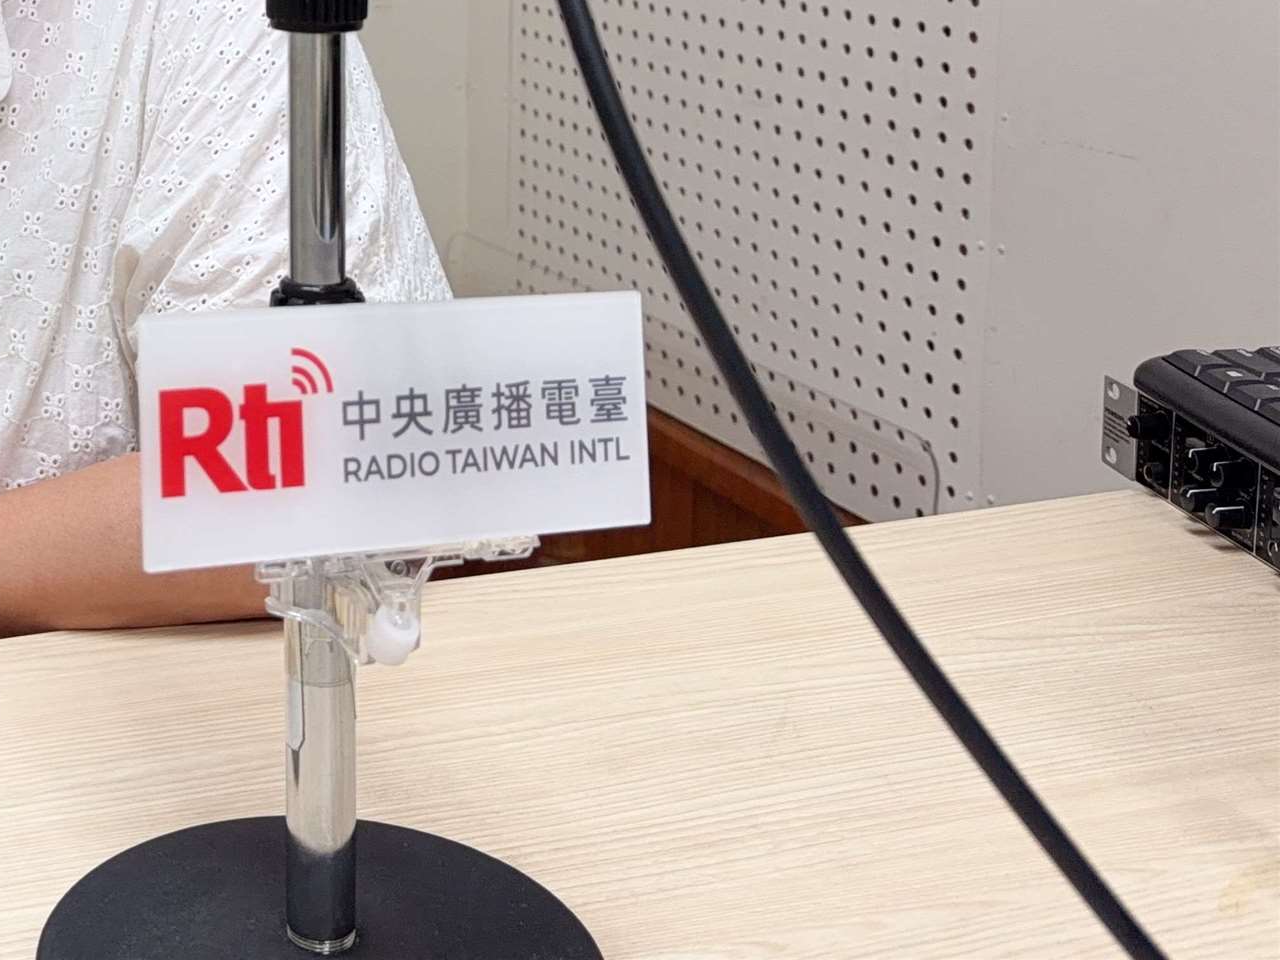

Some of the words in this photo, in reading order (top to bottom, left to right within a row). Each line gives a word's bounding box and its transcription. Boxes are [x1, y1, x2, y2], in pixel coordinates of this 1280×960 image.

[342, 374, 628, 441] 中央廣播電臺
[343, 450, 441, 483] RADIO
[444, 441, 559, 475] TAIWAN
[570, 436, 630, 465] INTL
